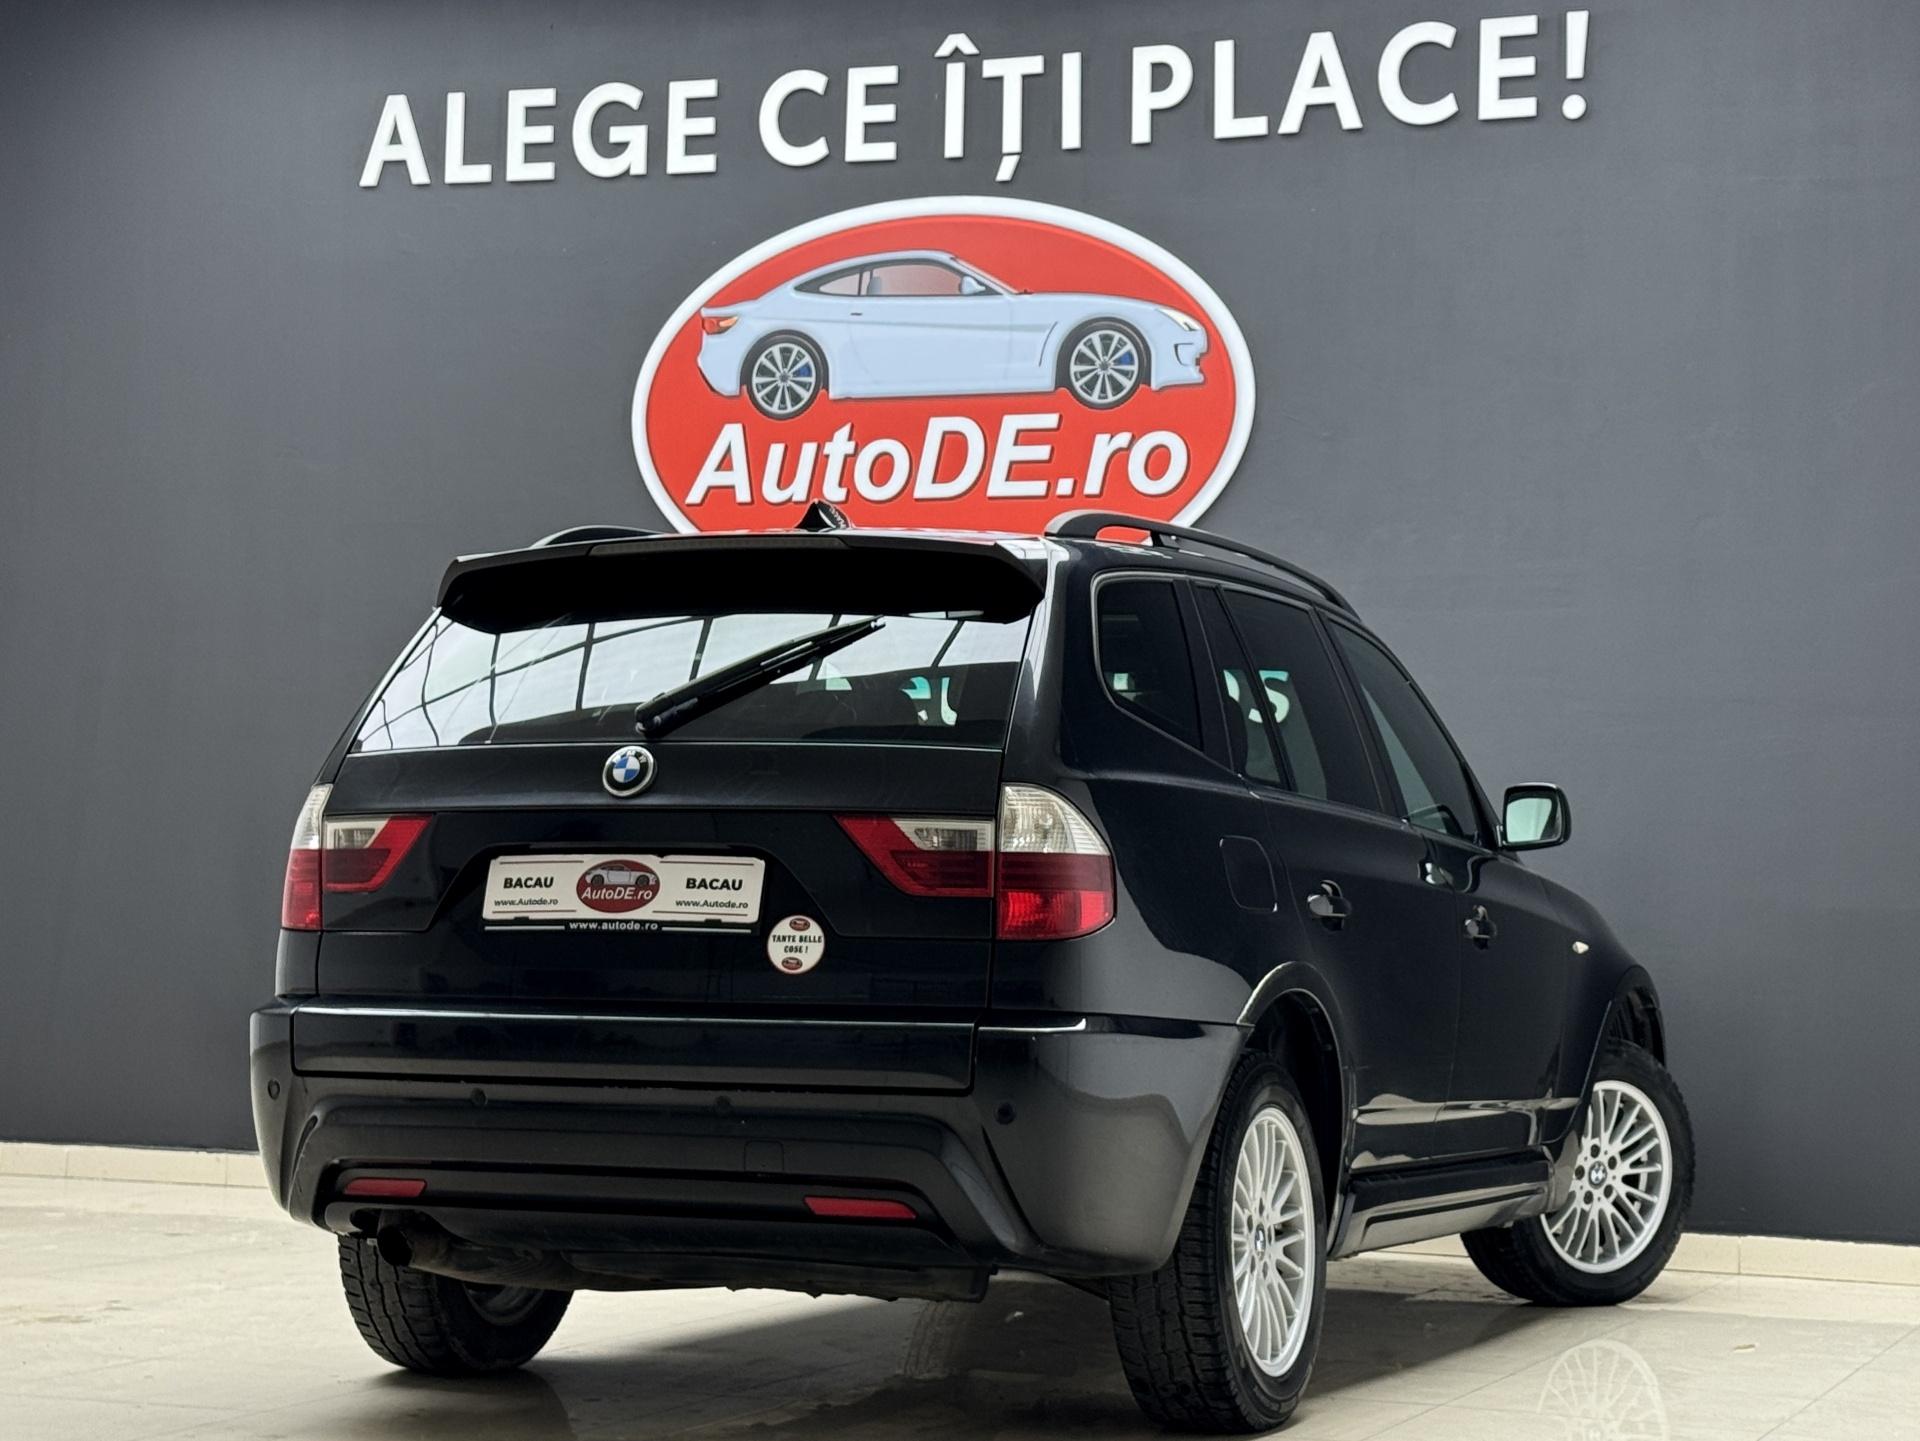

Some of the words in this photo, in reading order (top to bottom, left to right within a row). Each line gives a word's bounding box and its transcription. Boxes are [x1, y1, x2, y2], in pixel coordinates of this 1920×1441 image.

[359, 78, 718, 188] ALEGE
[758, 66, 899, 166] CE
[934, 32, 1082, 182] ÎȚI
[1131, 9, 1590, 144] PLACE!
[685, 413, 1190, 505] AutoDE.ro
[503, 876, 554, 889] BACAU
[685, 877, 743, 891] BACAU
[581, 886, 653, 900] AutoDE.ro
[494, 898, 559, 906] www.Autode.ro
[675, 900, 749, 909] www.Autode.ro
[569, 921, 658, 930] www.autode.ro
[772, 935, 796, 943] TANTE
[799, 935, 822, 943] BELLE
[784, 945, 803, 953] COSE
